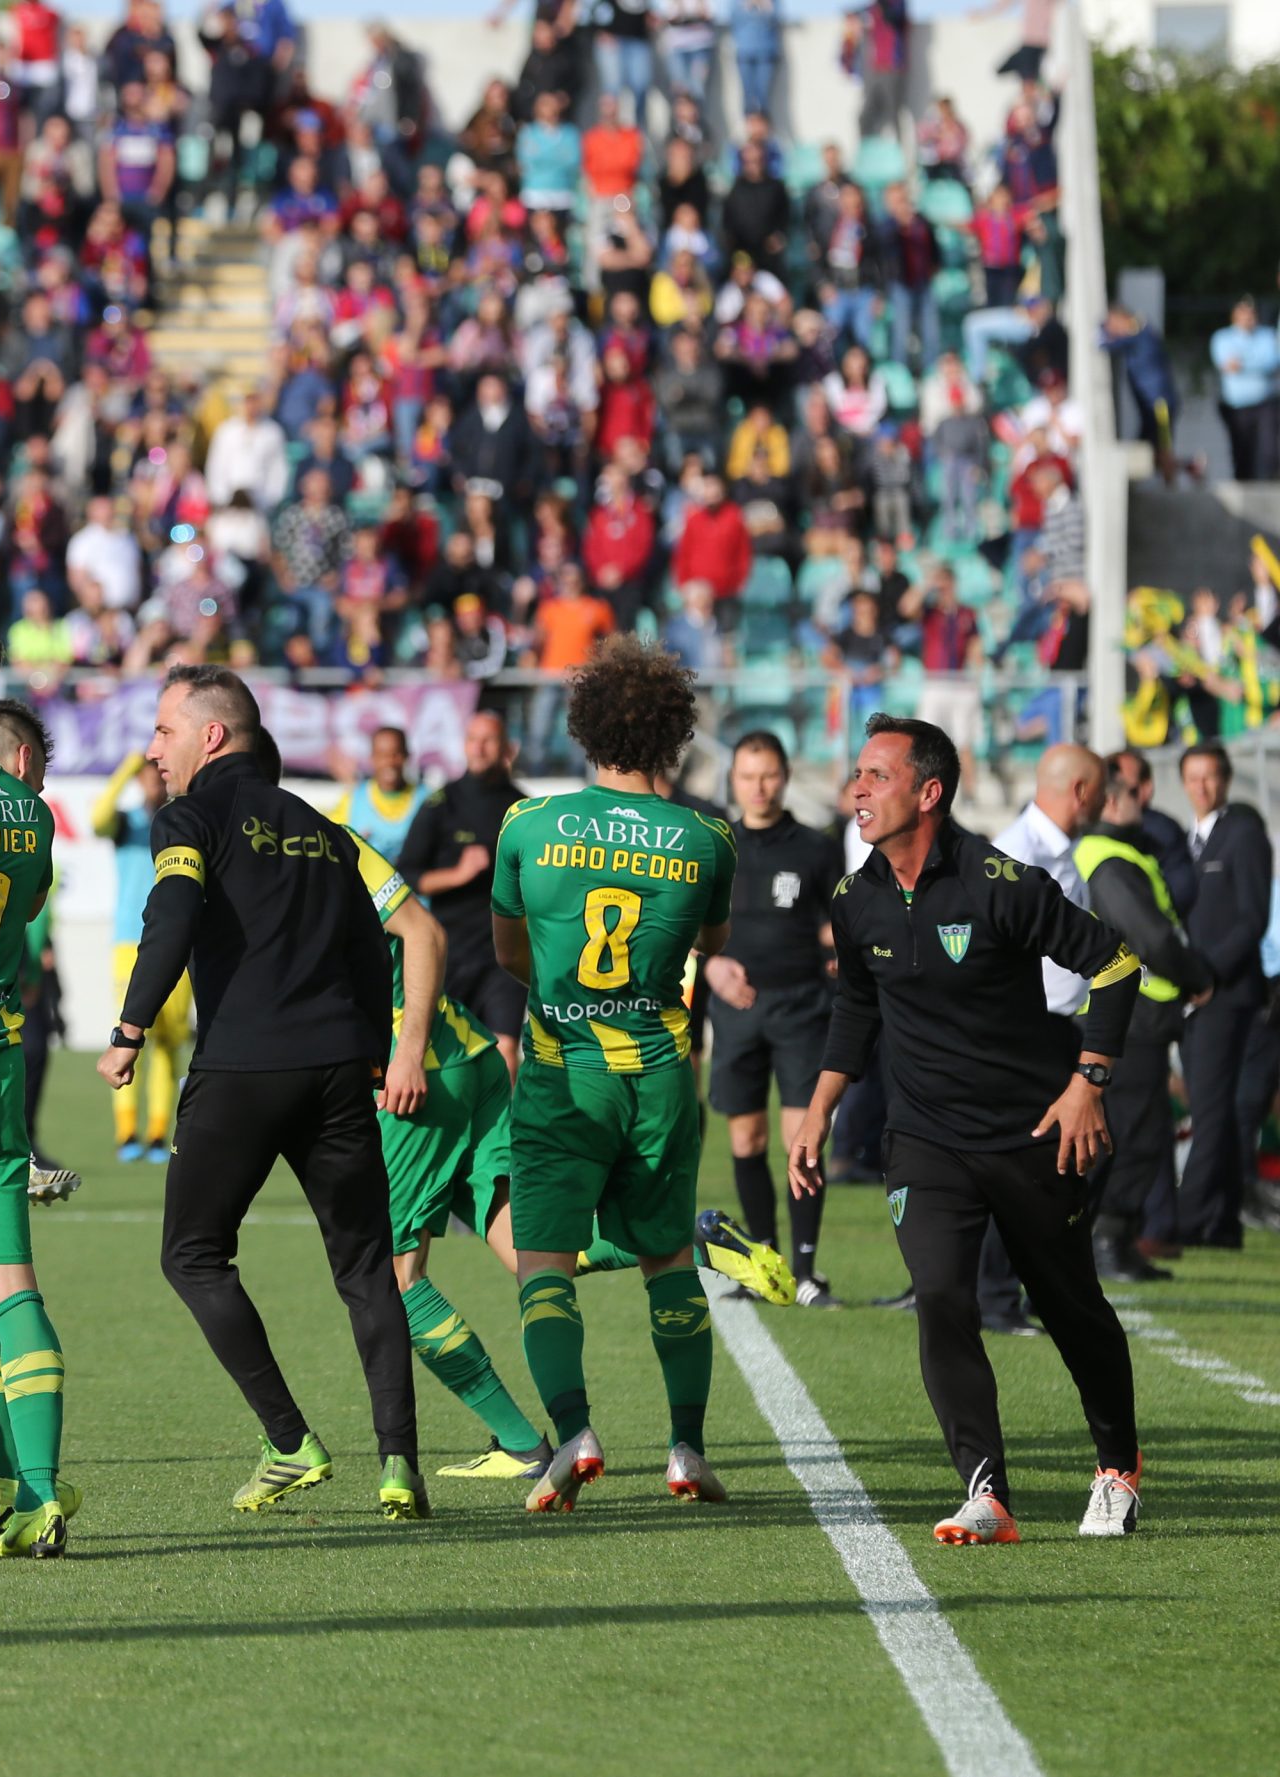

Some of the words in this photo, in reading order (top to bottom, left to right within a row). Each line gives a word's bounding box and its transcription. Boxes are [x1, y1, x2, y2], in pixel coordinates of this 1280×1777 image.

[282, 830, 340, 864] cdt
[556, 813, 685, 852] CABRIZ
[536, 839, 605, 871] JOÃO
[612, 850, 700, 884] PEDRO
[576, 886, 643, 991] 8
